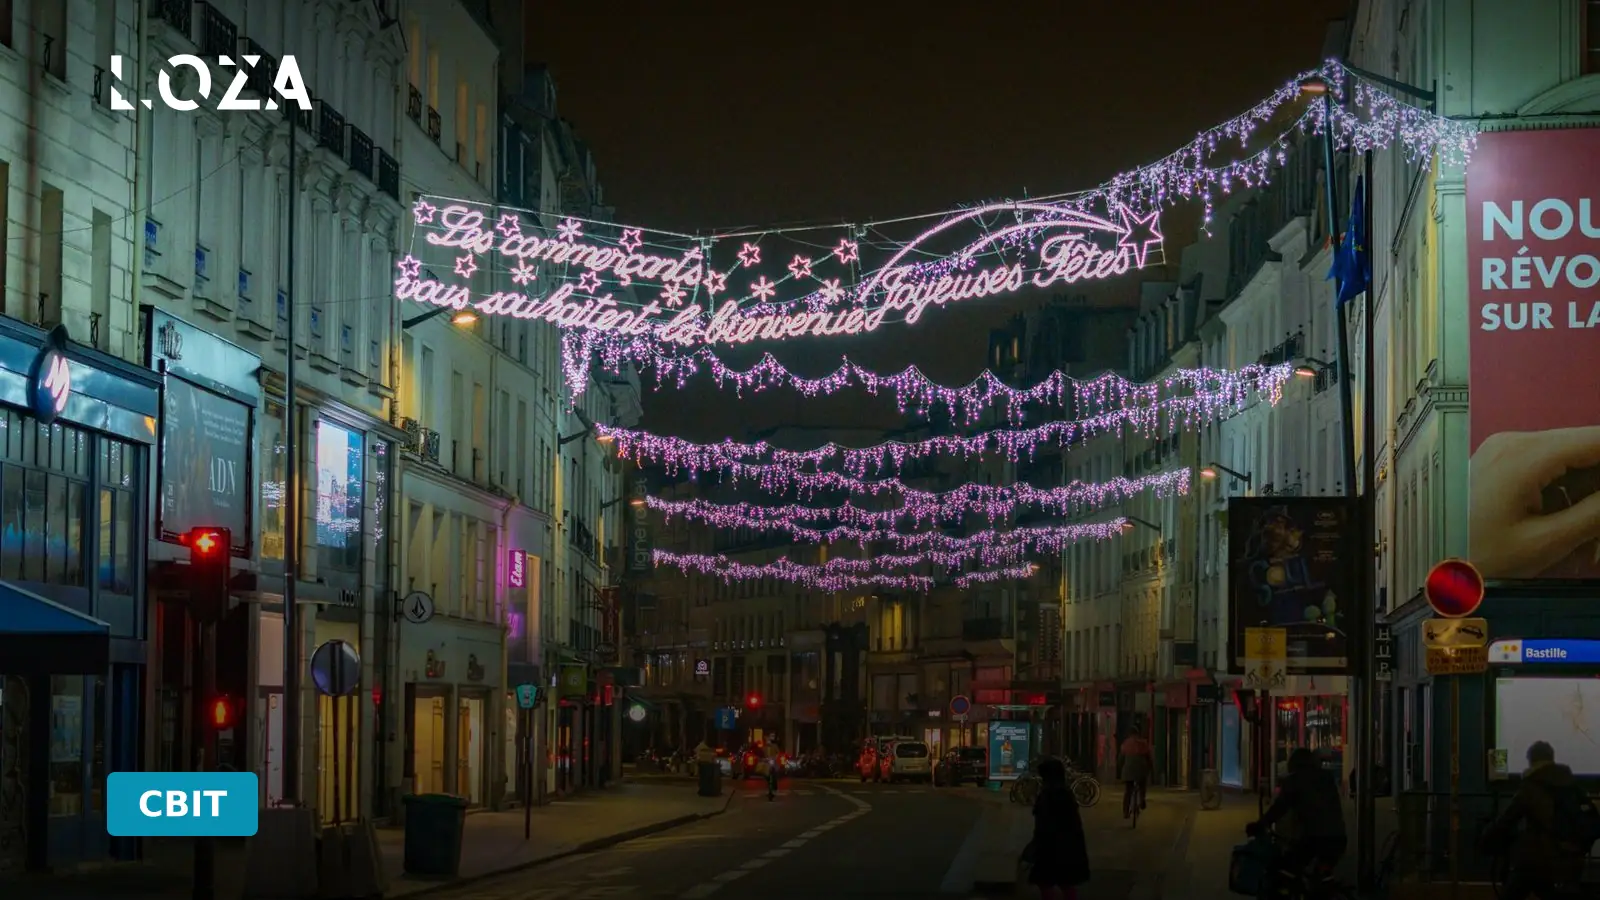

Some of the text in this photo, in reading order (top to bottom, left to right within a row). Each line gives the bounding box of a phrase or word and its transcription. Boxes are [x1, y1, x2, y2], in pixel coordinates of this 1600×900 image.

[1482, 198, 1600, 241] NOU
[427, 206, 705, 286] Les commerçants
[1482, 245, 1600, 290] RÉVO
[864, 234, 1130, 330] Joyeuses Fêtes
[395, 276, 470, 310] vous
[475, 285, 661, 336] souhaitent
[705, 300, 868, 345] bienvenue
[1480, 302, 1554, 331] SUR
[207, 456, 236, 496] ADN
[635, 477, 648, 526] roet
[1525, 647, 1568, 660] Bastille
